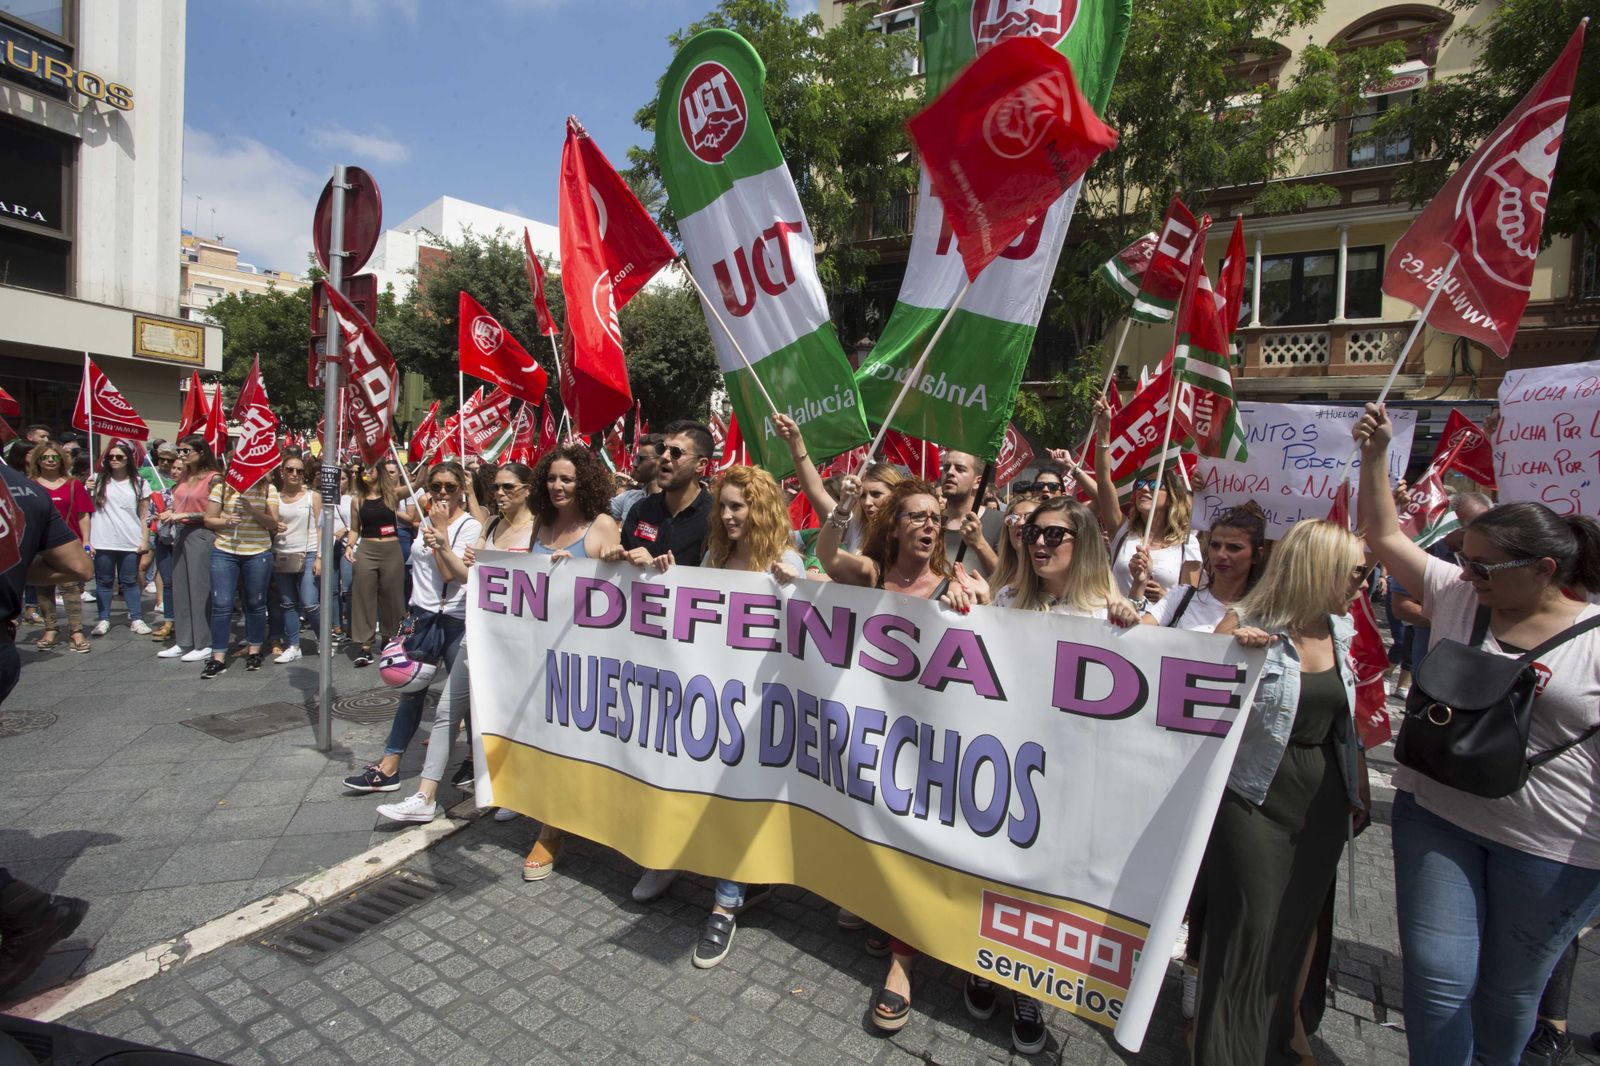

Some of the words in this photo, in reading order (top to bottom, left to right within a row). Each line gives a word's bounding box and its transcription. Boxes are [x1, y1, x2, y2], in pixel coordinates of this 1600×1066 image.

[684, 72, 736, 134] UGT
[478, 565, 551, 622] EN
[574, 576, 1008, 702] DEFENSA
[1051, 640, 1247, 738] DE
[545, 648, 747, 768] NUESTROS
[758, 682, 1047, 849] DERECHOS
[991, 902, 1123, 974] CCOO
[975, 948, 1125, 1022] servicios
